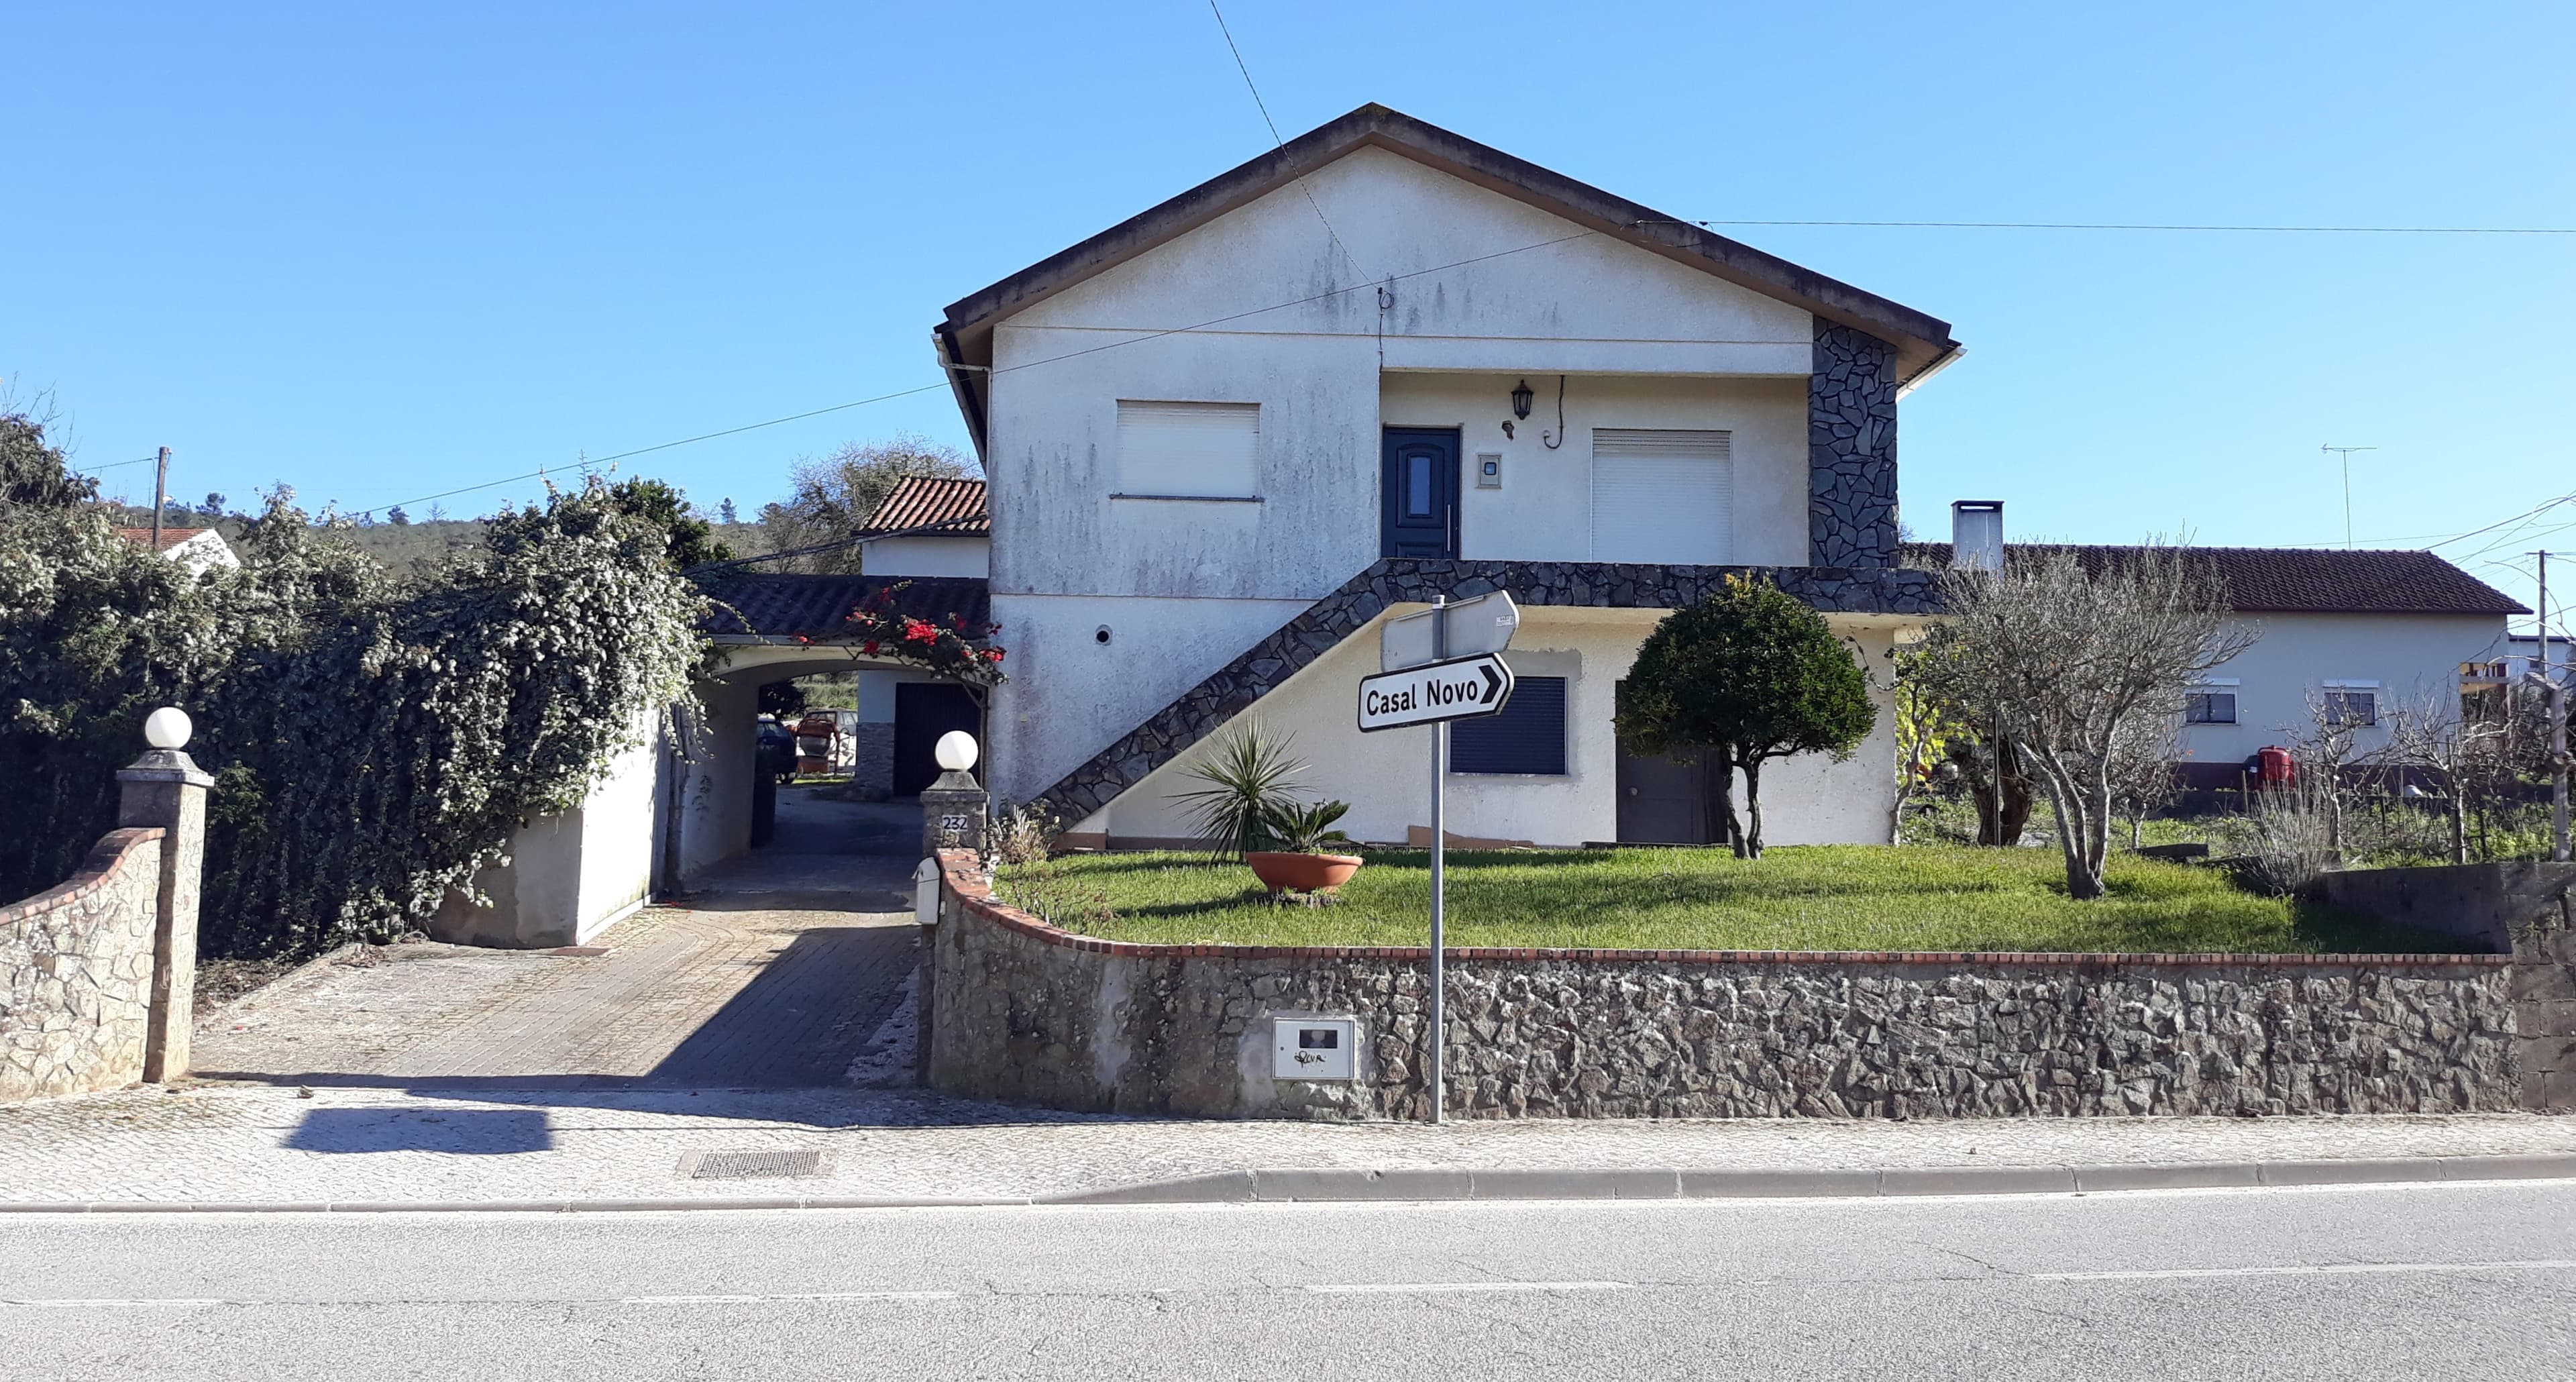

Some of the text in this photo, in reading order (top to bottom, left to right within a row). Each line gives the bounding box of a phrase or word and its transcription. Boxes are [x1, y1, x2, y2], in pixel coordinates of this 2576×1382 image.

[1366, 679, 1478, 716] Casal Novo
[943, 816, 967, 830] 232
